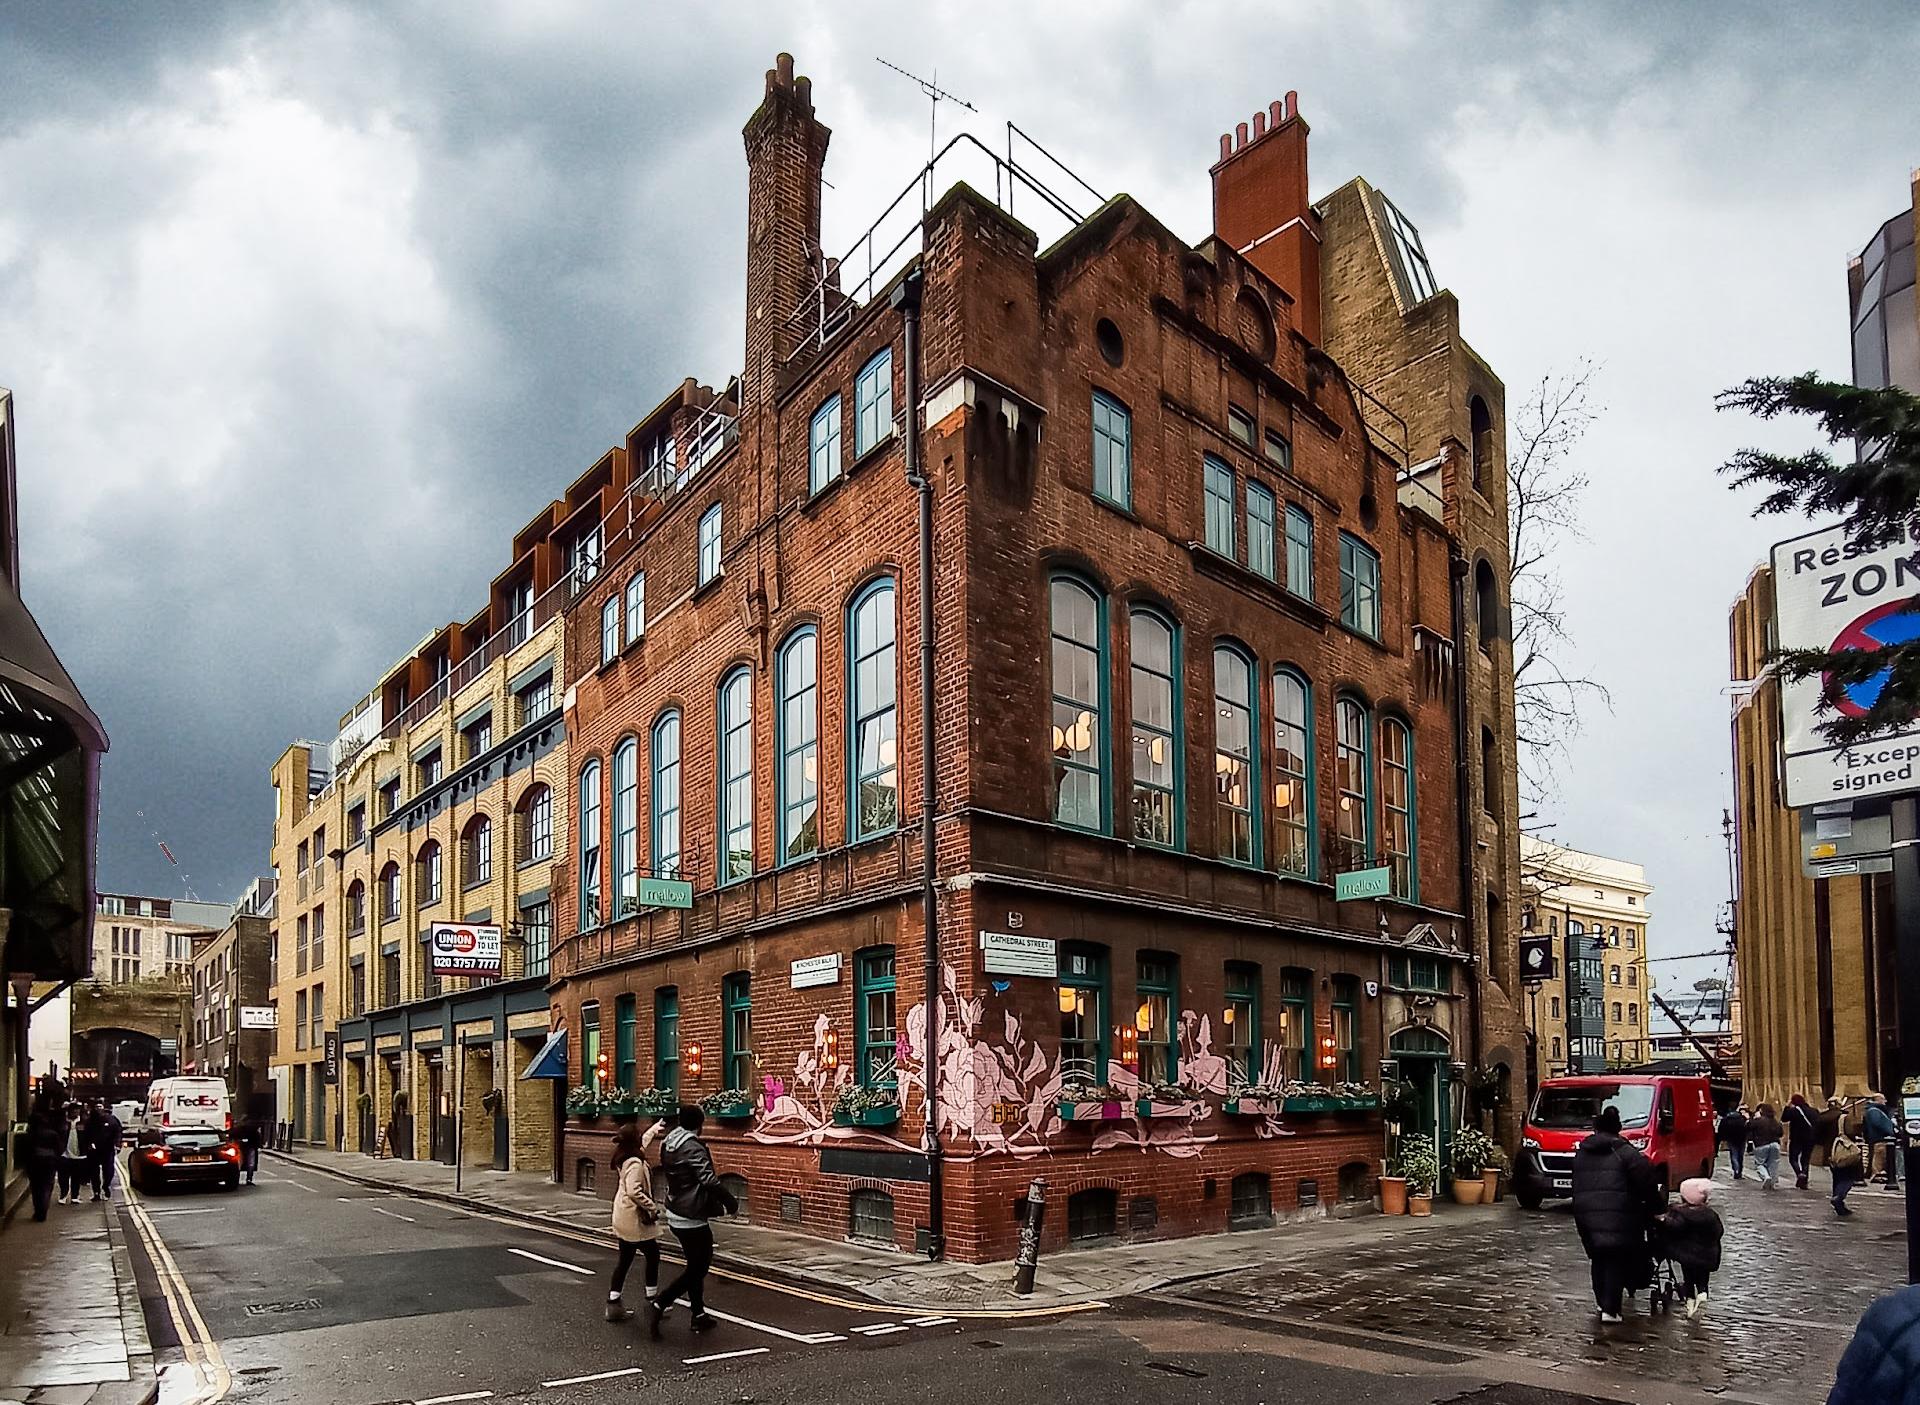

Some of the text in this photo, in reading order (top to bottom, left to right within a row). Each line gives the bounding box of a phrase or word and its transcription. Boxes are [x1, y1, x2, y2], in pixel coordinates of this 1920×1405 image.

[1833, 764, 1911, 790] signed
[438, 934, 472, 945] UNION
[478, 941, 498, 950] TO LET
[990, 935, 1026, 947] CATHEDRAL
[1027, 939, 1049, 949] STREET
[434, 957, 500, 970] 020 3757 7777
[177, 1095, 218, 1106] FedEx
